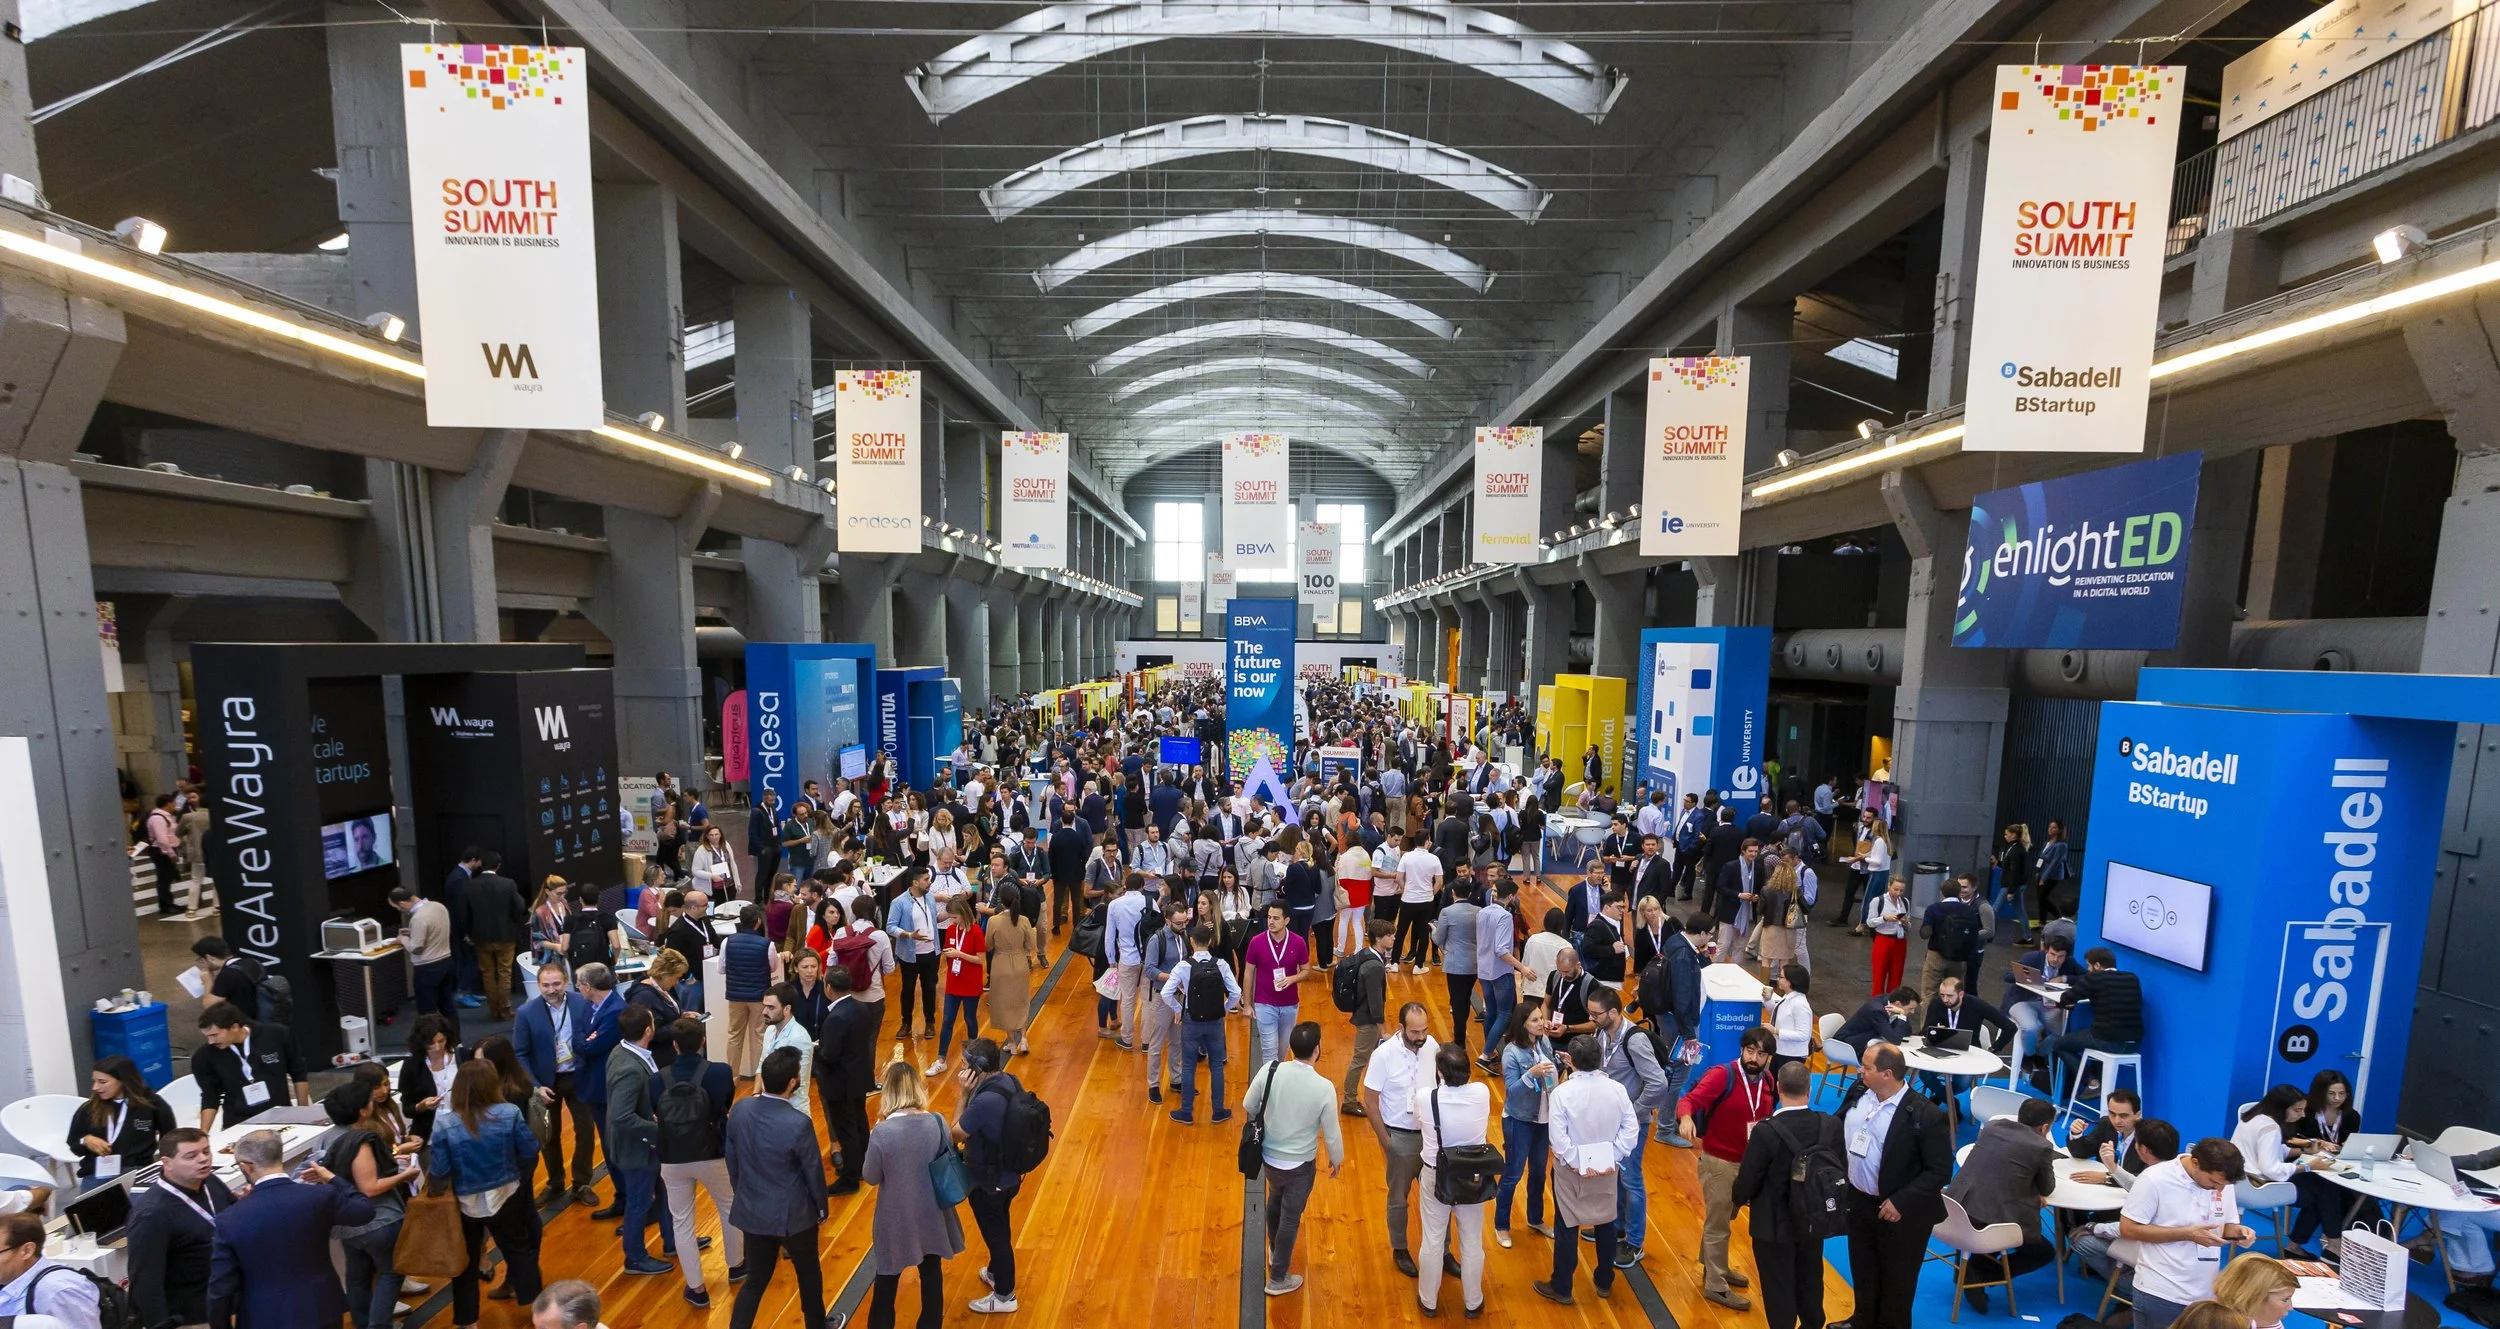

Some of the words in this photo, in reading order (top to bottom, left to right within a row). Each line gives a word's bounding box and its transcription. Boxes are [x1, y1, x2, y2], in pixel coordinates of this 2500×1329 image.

[442, 178, 558, 209] SOUTH
[2016, 201, 2136, 230] SOUTH
[443, 210, 558, 236] SUMMIT
[444, 236, 500, 247] INNOVATION
[502, 237, 511, 247] IS
[513, 237, 560, 248] BUSINESS
[2014, 233, 2133, 257] SUMMIT
[2012, 259, 2069, 269] INNOVATION
[2072, 260, 2080, 269] IS
[2083, 259, 2130, 270] BUSINESS
[2016, 366, 2122, 389] Sabadell
[513, 383, 543, 394] wayra
[2015, 397, 2096, 415] BStartup
[1664, 425, 1728, 440] SOUTH
[851, 433, 905, 447] SOUTH
[851, 448, 905, 460] SUMMIT
[1663, 441, 1727, 454] SUMMIT
[1013, 478, 1055, 489] SOUTH
[1234, 480, 1277, 491] SOUTH
[1486, 473, 1529, 484] SOUTH
[1013, 489, 1055, 499] SUMMIT
[1486, 484, 1528, 493] SUMMIT
[1234, 491, 1277, 501] SUMMIT
[848, 515, 911, 529] endesa
[1661, 510, 1684, 533] ie
[1481, 532, 1532, 545] ferrovial
[1236, 542, 1276, 555] BBVA
[1993, 511, 2183, 587] enlightED
[1303, 574, 1335, 588] 100
[2074, 575, 2125, 586] REINVENTING
[2126, 571, 2175, 583] EDUCATION
[2073, 589, 2082, 598] IN
[2082, 589, 2089, 598] A
[2089, 588, 2118, 598] DIGITAL
[2120, 586, 2150, 596] WORLD
[1234, 615, 1267, 626] BBVA
[1234, 640, 1263, 654] The
[1234, 655, 1281, 669] future
[1234, 669, 1247, 683] is
[1250, 672, 1277, 683] our
[1234, 687, 1265, 698] now
[463, 719, 494, 729] wayra
[1742, 709, 1753, 763] UNIVERSITY
[312, 737, 344, 759] cale
[2131, 743, 2239, 786] Sabadell
[316, 762, 371, 784] tartups
[1719, 765, 1758, 800] ie
[2128, 782, 2208, 820] BStartup
[2293, 758, 2389, 1022] Sabadell
[1715, 1013, 1754, 1022] Sabadell
